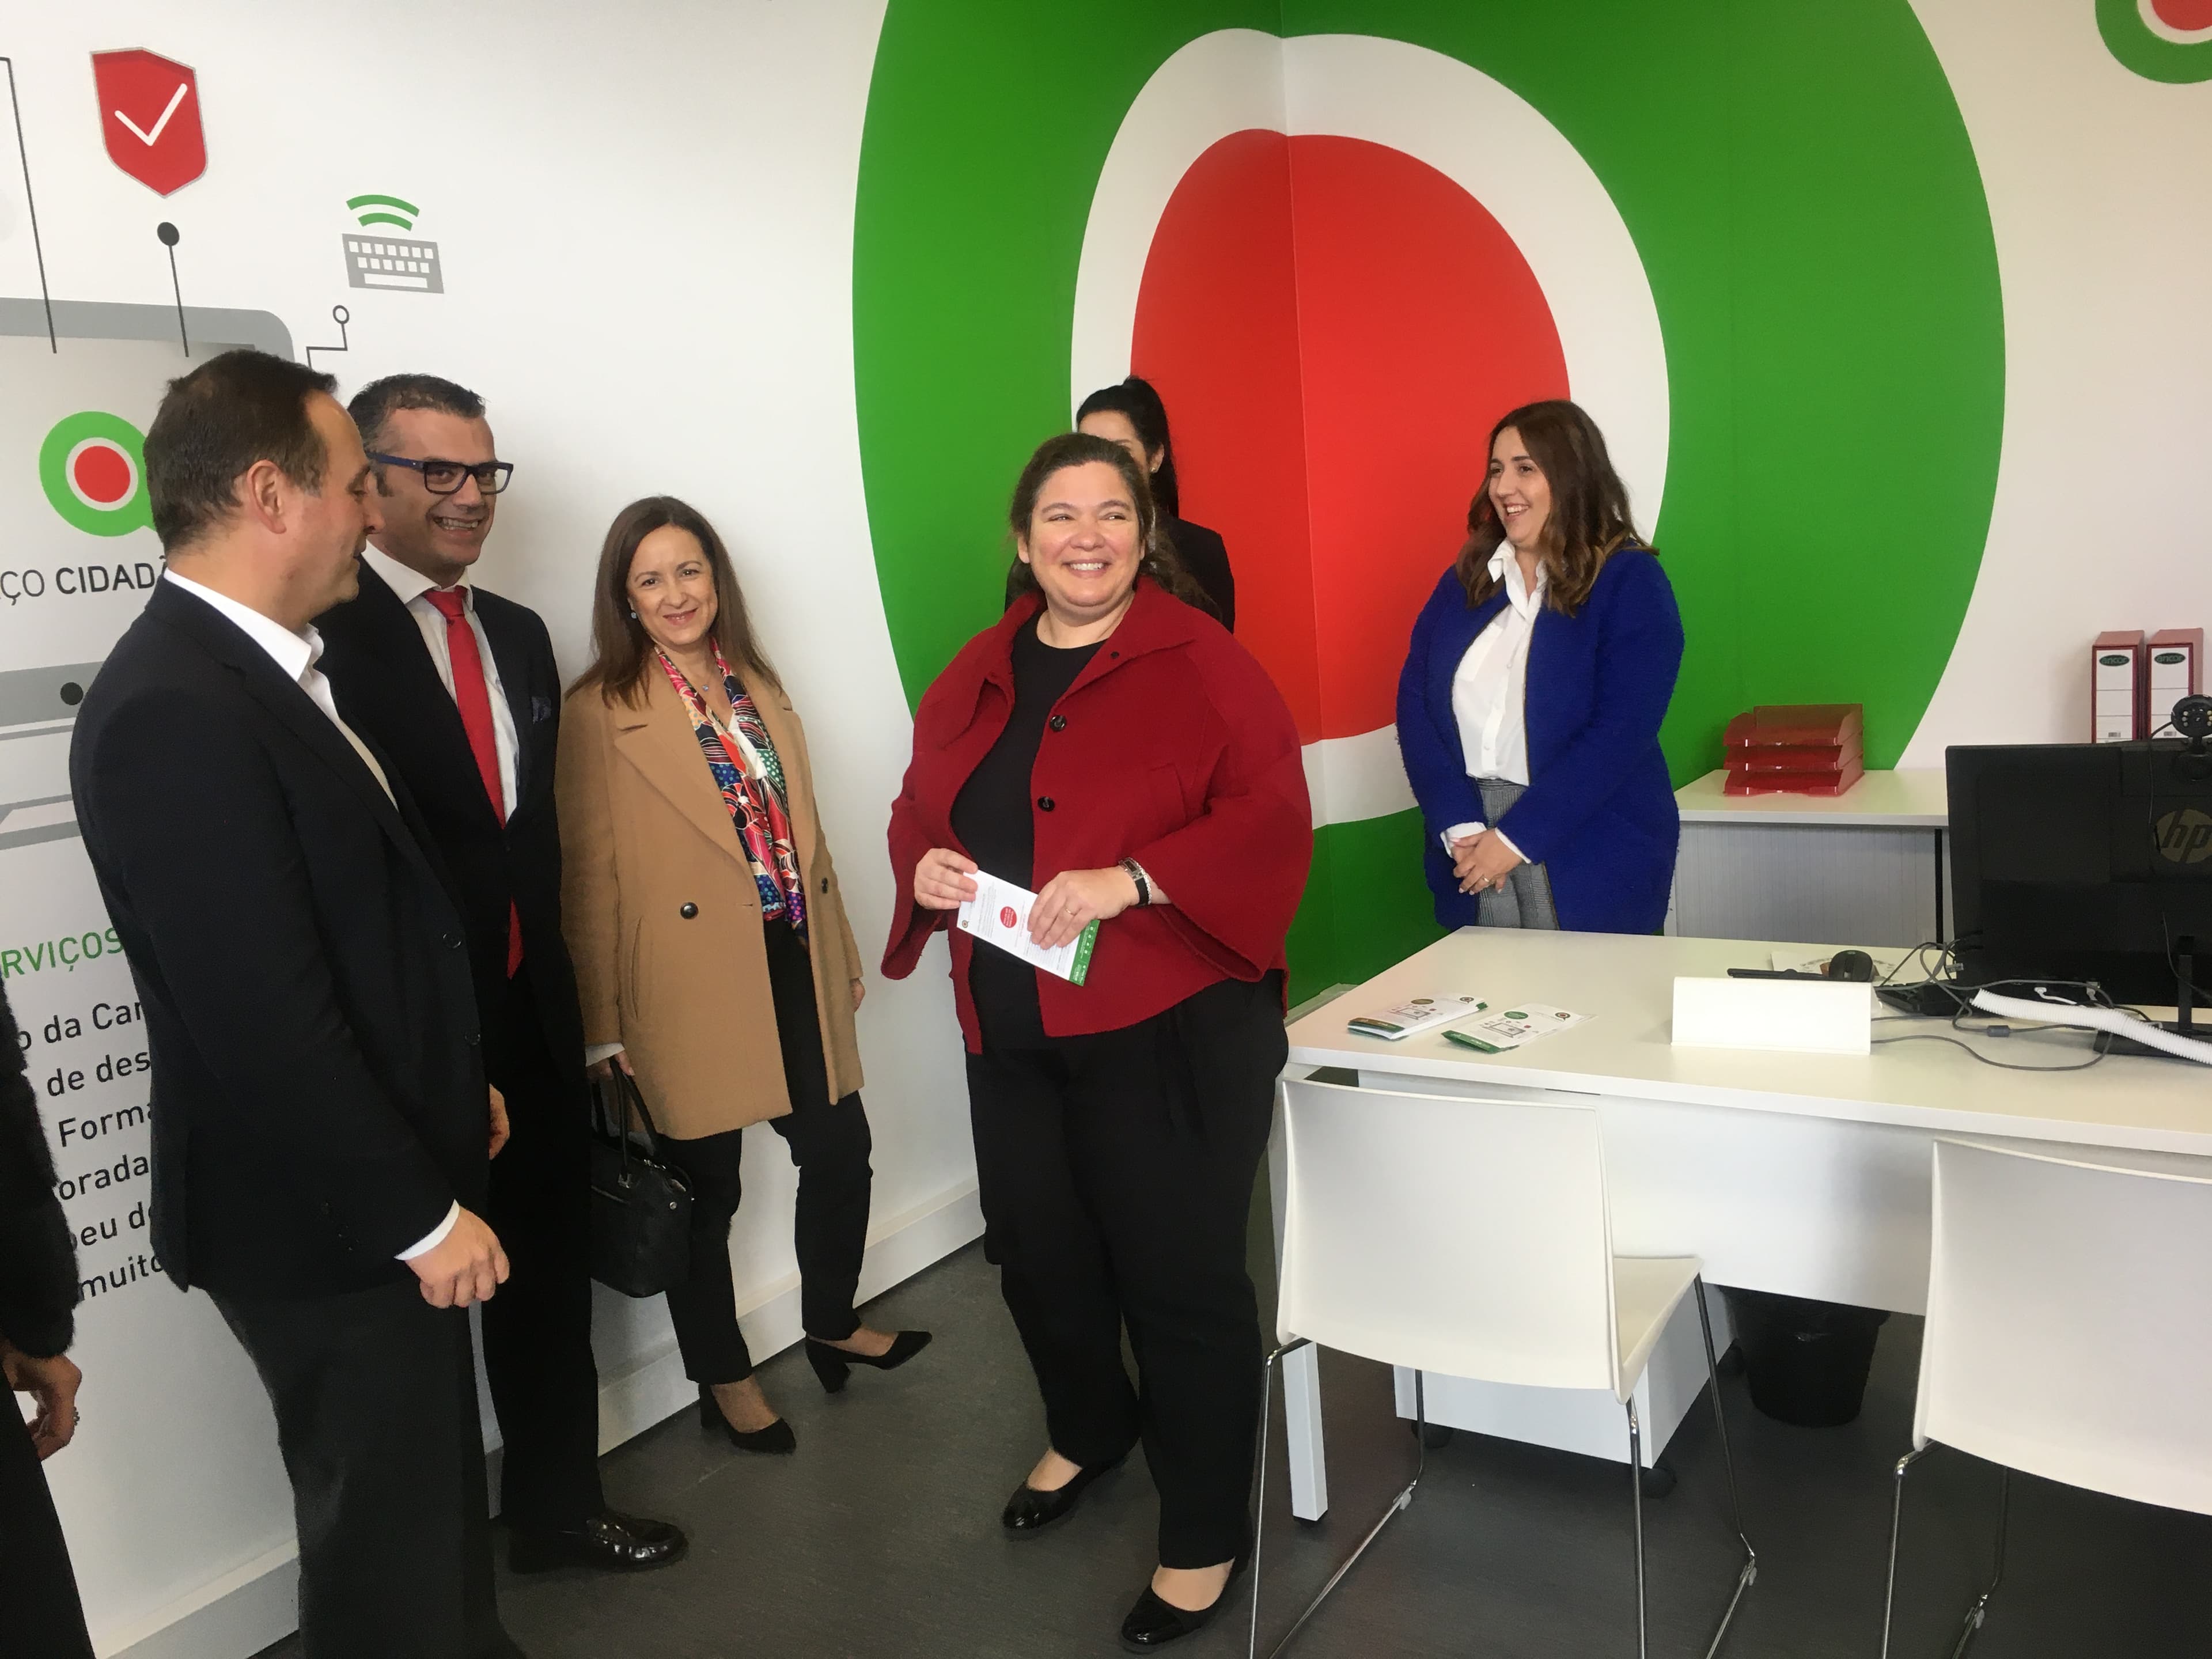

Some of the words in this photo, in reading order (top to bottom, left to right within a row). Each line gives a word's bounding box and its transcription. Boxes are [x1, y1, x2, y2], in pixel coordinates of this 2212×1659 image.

[0, 569, 45, 606] ÇO
[2161, 810, 2212, 863] hp
[1, 927, 124, 978] RVIÇOS
[44, 1015, 82, 1044] da
[47, 1068, 85, 1097] de
[96, 1052, 150, 1083] des
[59, 1103, 151, 1147] Form
[59, 1154, 149, 1200] orada
[70, 1218, 118, 1249] eu
[128, 1201, 151, 1229] d
